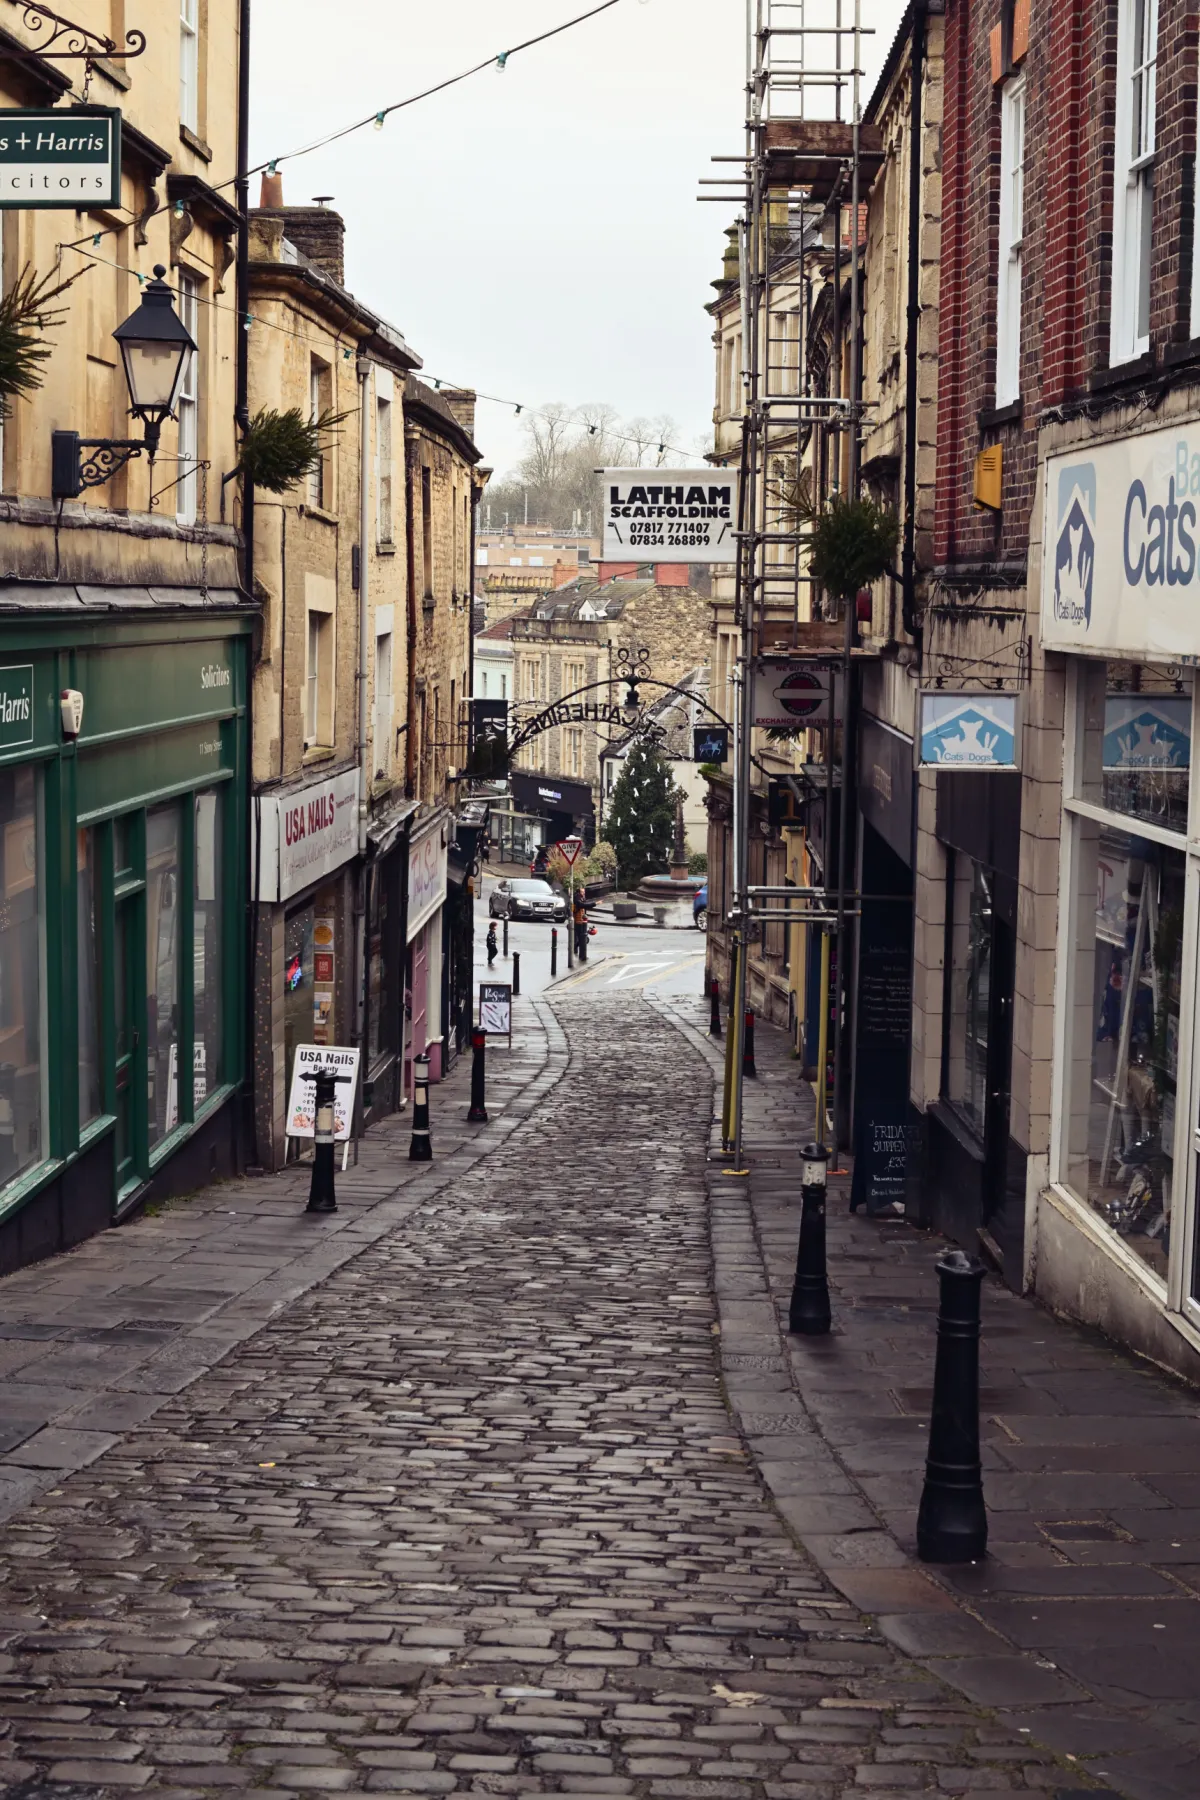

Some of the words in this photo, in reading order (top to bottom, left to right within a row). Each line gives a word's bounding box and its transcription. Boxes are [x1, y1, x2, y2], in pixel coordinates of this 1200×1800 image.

[36, 132, 104, 151] Harris
[610, 486, 731, 505] LATHAM
[610, 506, 731, 518] SCAFFOLDING
[630, 522, 664, 533] 07817
[667, 522, 710, 533] 771407
[1123, 475, 1197, 587] Cats
[630, 535, 664, 546] 07834
[668, 535, 711, 546] 268899
[201, 664, 230, 689] Solicitors
[0, 687, 30, 723] Harris
[756, 717, 796, 725] EXCHANGE
[944, 752, 964, 761] Cats
[969, 752, 991, 763] Dogs
[286, 806, 306, 847] USA
[308, 792, 335, 836] NAILS
[300, 1051, 322, 1063] USA
[326, 1053, 355, 1066] Nails
[313, 1064, 339, 1073] Beauty
